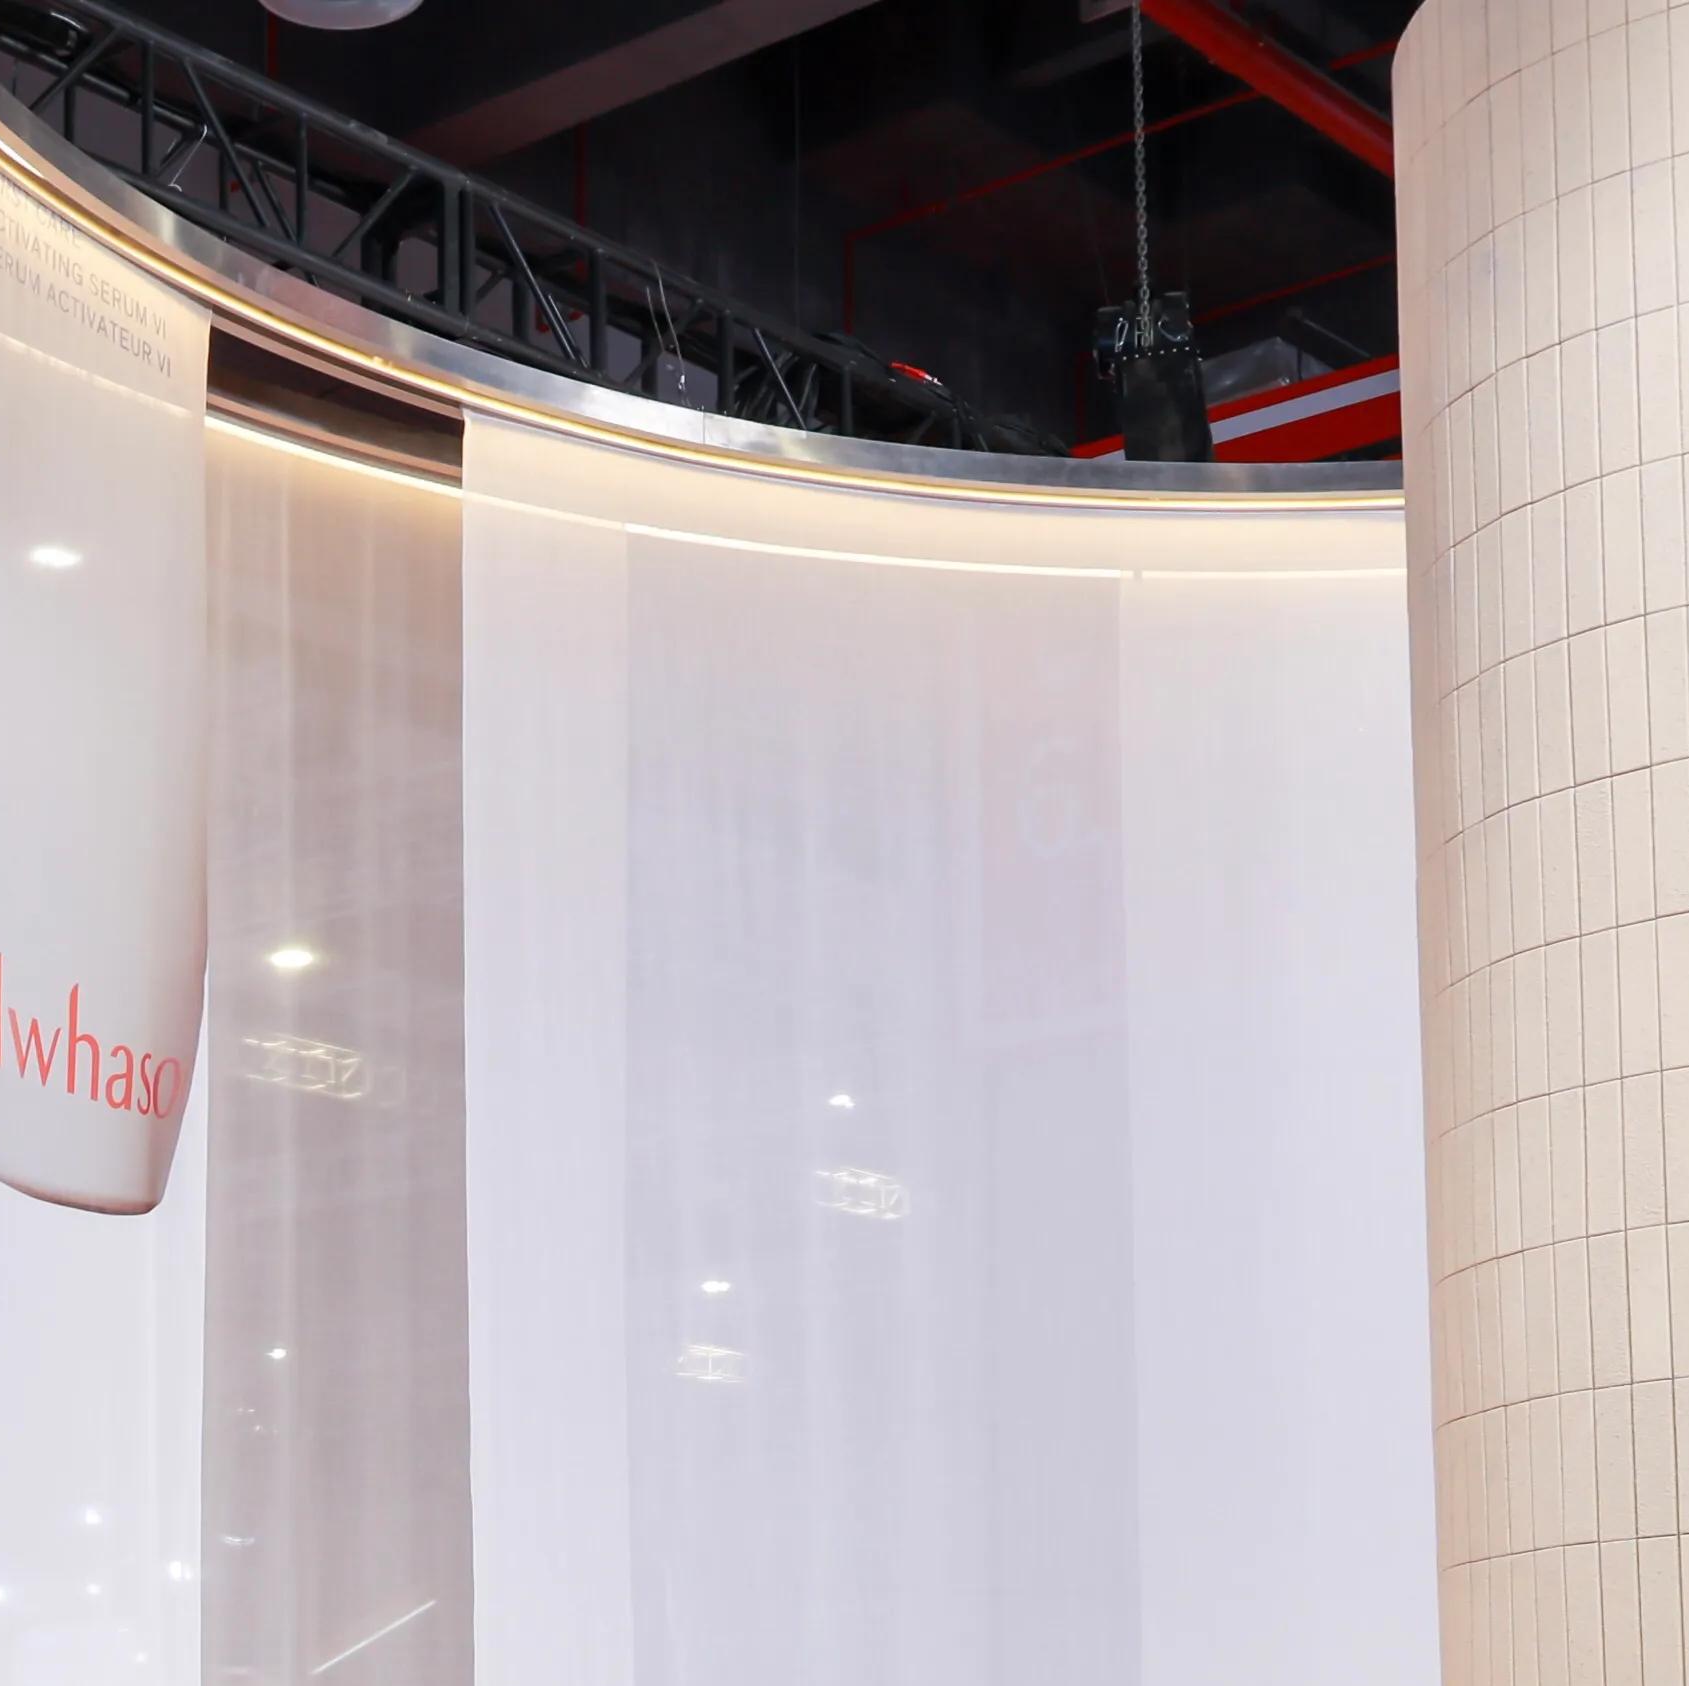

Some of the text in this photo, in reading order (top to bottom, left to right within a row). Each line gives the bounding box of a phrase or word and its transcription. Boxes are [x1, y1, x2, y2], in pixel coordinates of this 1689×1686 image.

[46, 282, 152, 365] ACTIVATEUR
[156, 348, 171, 378] VI
[89, 273, 147, 328] SERUM
[152, 312, 166, 340] VI
